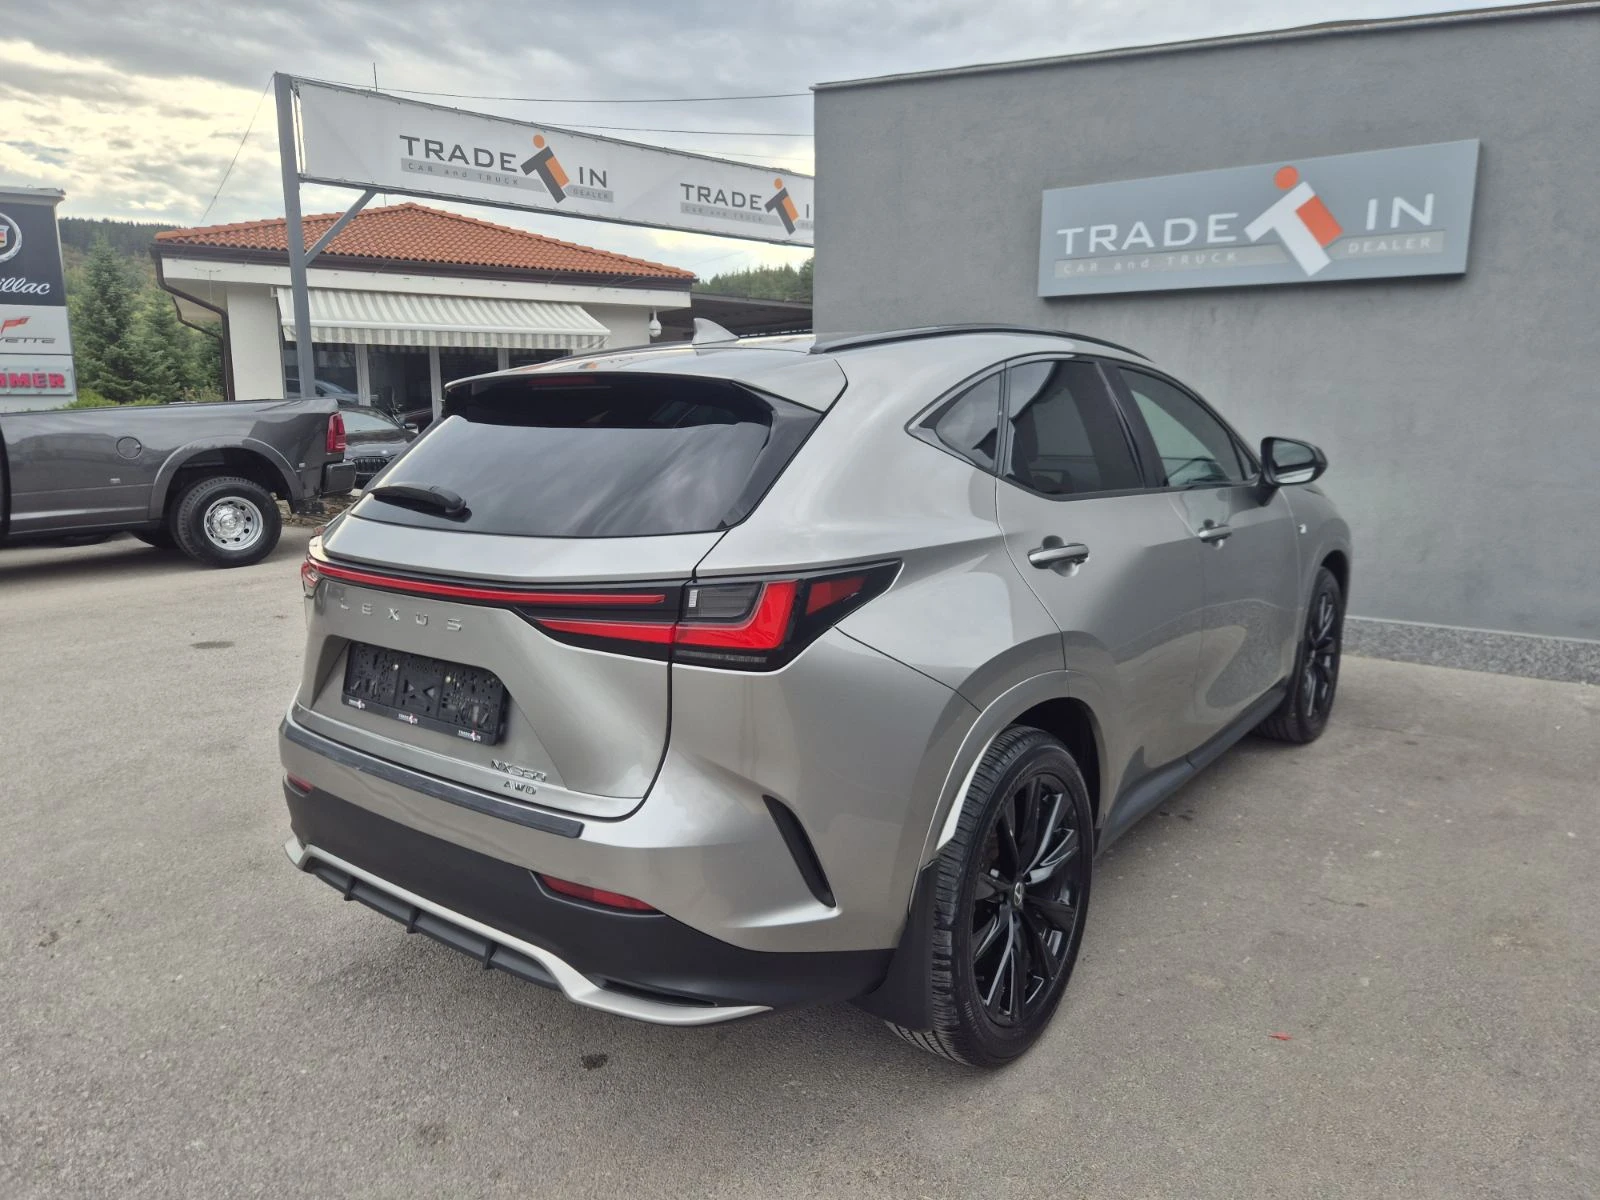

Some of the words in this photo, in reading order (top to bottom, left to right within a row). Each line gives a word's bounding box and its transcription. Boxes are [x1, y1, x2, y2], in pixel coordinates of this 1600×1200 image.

[400, 135, 518, 173] TRADE
[578, 166, 608, 189] IN
[408, 162, 434, 173] CAR
[444, 169, 468, 178] and
[478, 173, 520, 185] TRUCK
[680, 183, 763, 212] TRADE
[1056, 212, 1239, 255] TRADE
[1365, 192, 1435, 231] IN
[1063, 262, 1098, 275] CAR
[1113, 257, 1150, 272] and
[1167, 251, 1238, 268] TRUCK
[1347, 237, 1432, 254] DEALER
[0, 372, 66, 389] MER
[340, 597, 463, 632] LEXUS
[504, 780, 537, 795] AWD
